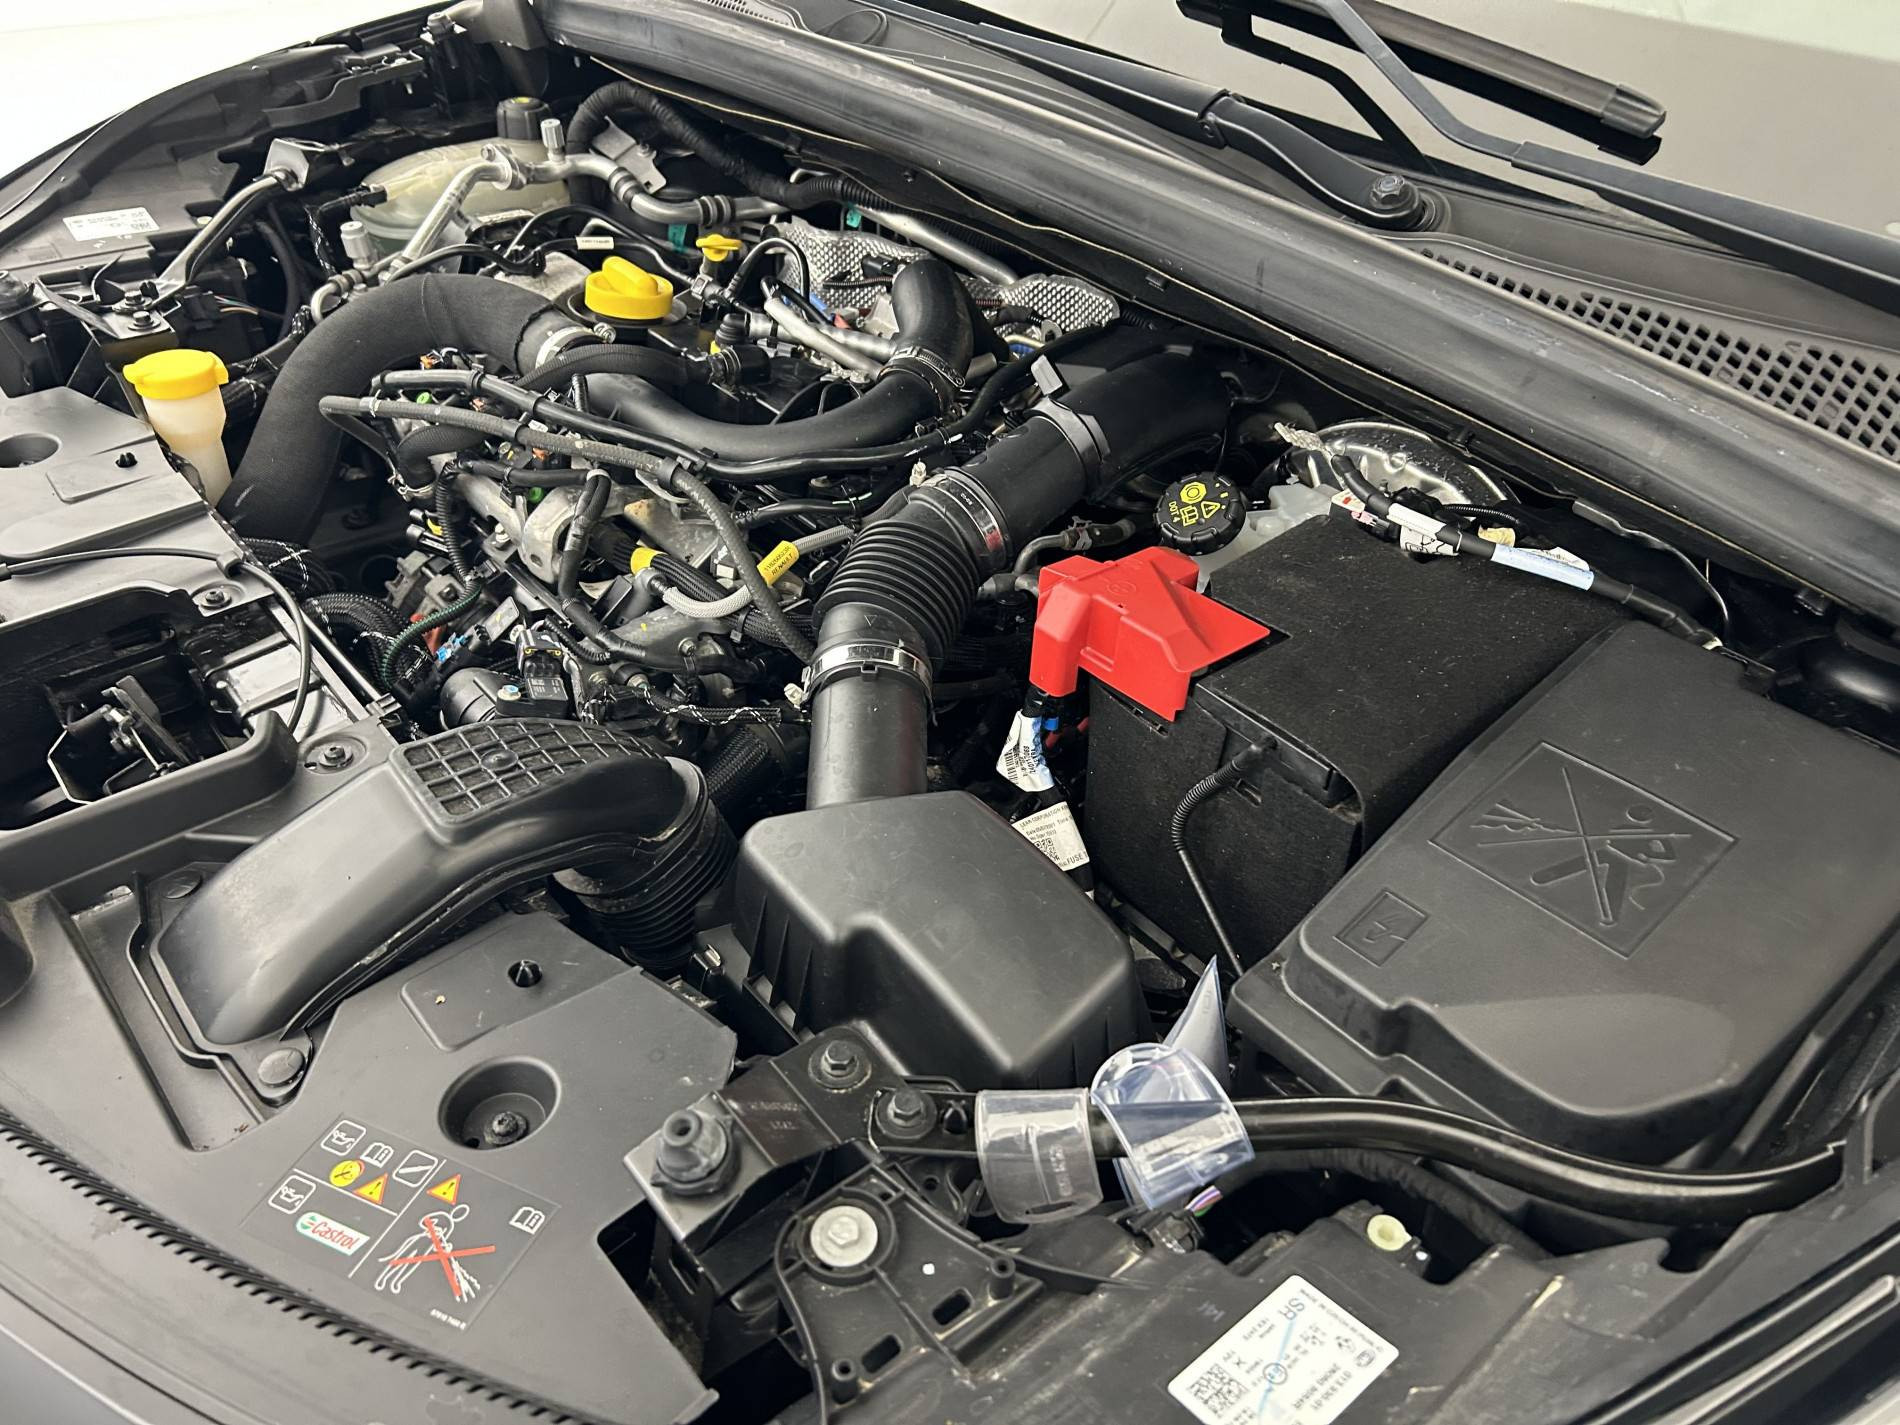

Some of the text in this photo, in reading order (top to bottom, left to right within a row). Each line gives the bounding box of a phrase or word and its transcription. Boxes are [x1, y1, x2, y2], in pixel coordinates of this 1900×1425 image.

[1169, 501, 1179, 516] DOT
[772, 553, 793, 575] RENAULT
[1066, 852, 1084, 864] FUSE
[311, 1221, 360, 1250] Castrol
